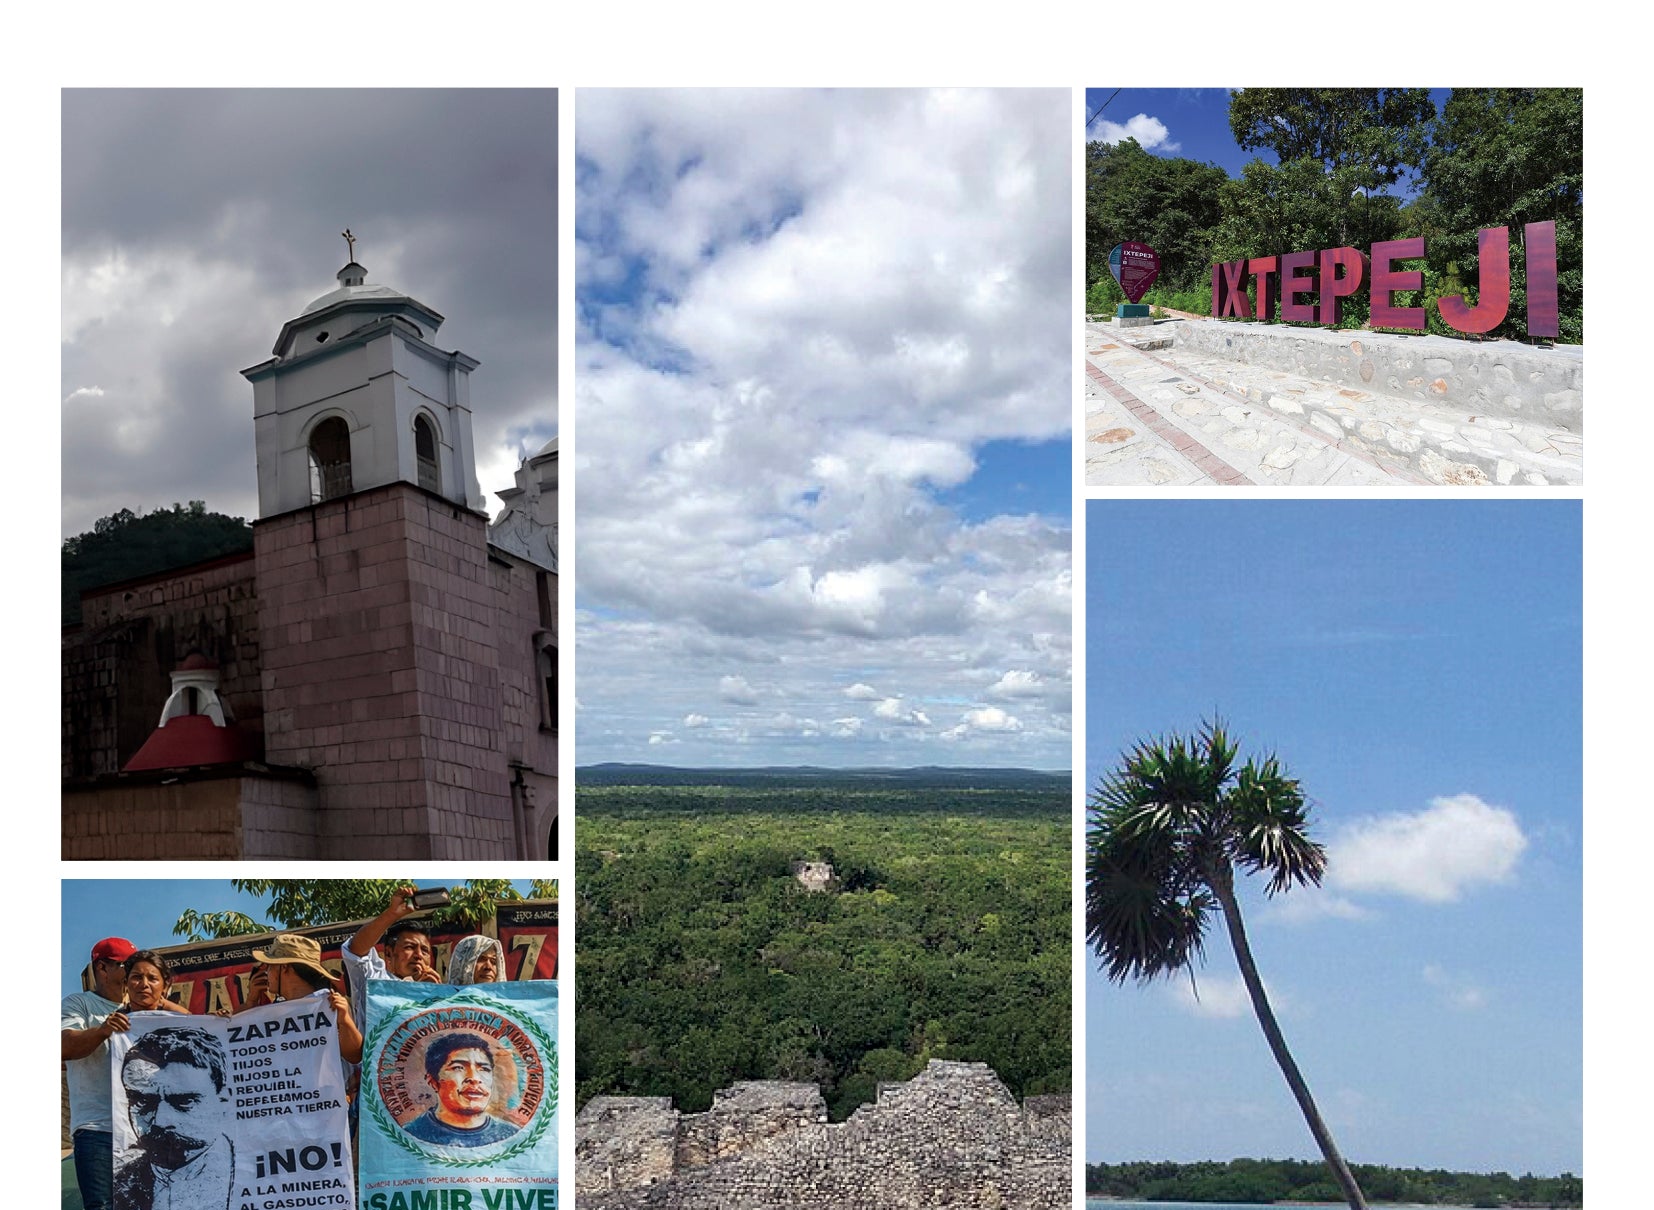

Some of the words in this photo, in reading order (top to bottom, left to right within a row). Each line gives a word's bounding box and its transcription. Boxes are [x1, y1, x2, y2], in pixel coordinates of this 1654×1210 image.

[1211, 220, 1559, 338] IXTEPEJI
[227, 1011, 332, 1043] ZAPATA
[230, 1043, 276, 1058] TODOS
[281, 1036, 327, 1051] SOMOS
[285, 1067, 302, 1077] LA
[236, 1106, 292, 1120] NUESTRA
[296, 1099, 341, 1113] TIERRA
[256, 1142, 342, 1179] ¡NO!
[241, 1188, 252, 1197] A
[257, 1184, 277, 1196] LA
